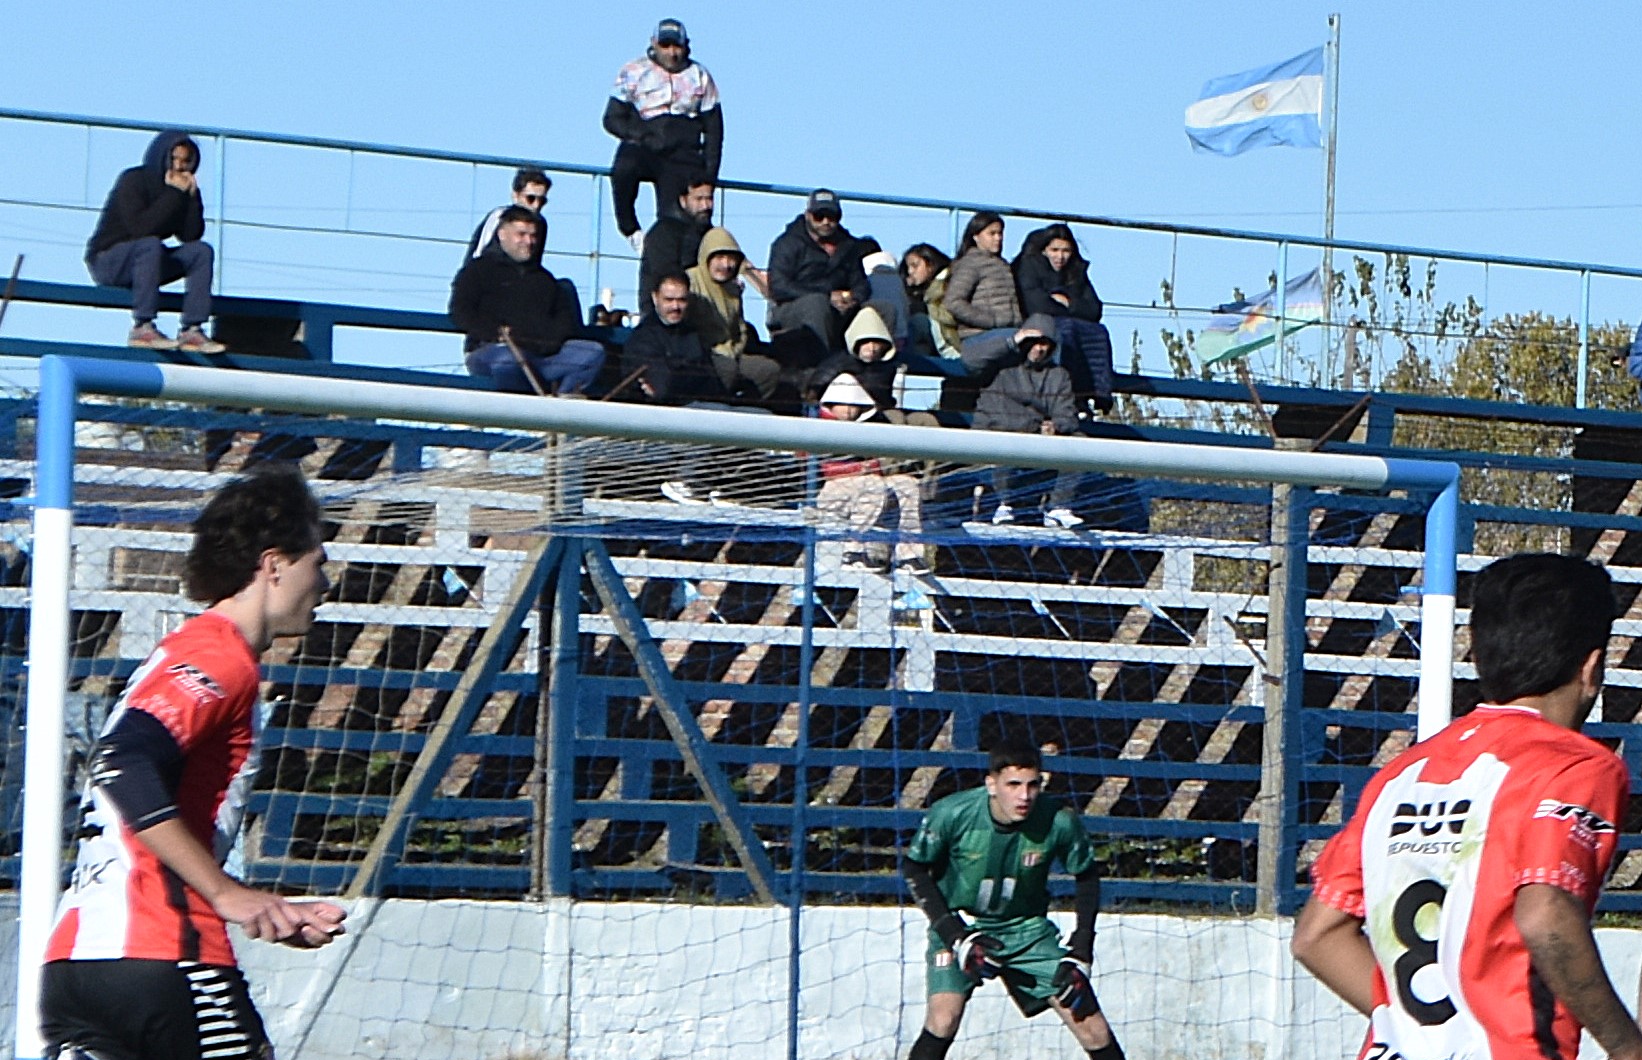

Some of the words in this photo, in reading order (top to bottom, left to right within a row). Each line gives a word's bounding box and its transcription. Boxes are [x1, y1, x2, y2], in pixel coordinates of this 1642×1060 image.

[1388, 799, 1472, 838] DUO
[1387, 841, 1463, 856] EPUESTO
[1392, 879, 1458, 1026] 8
